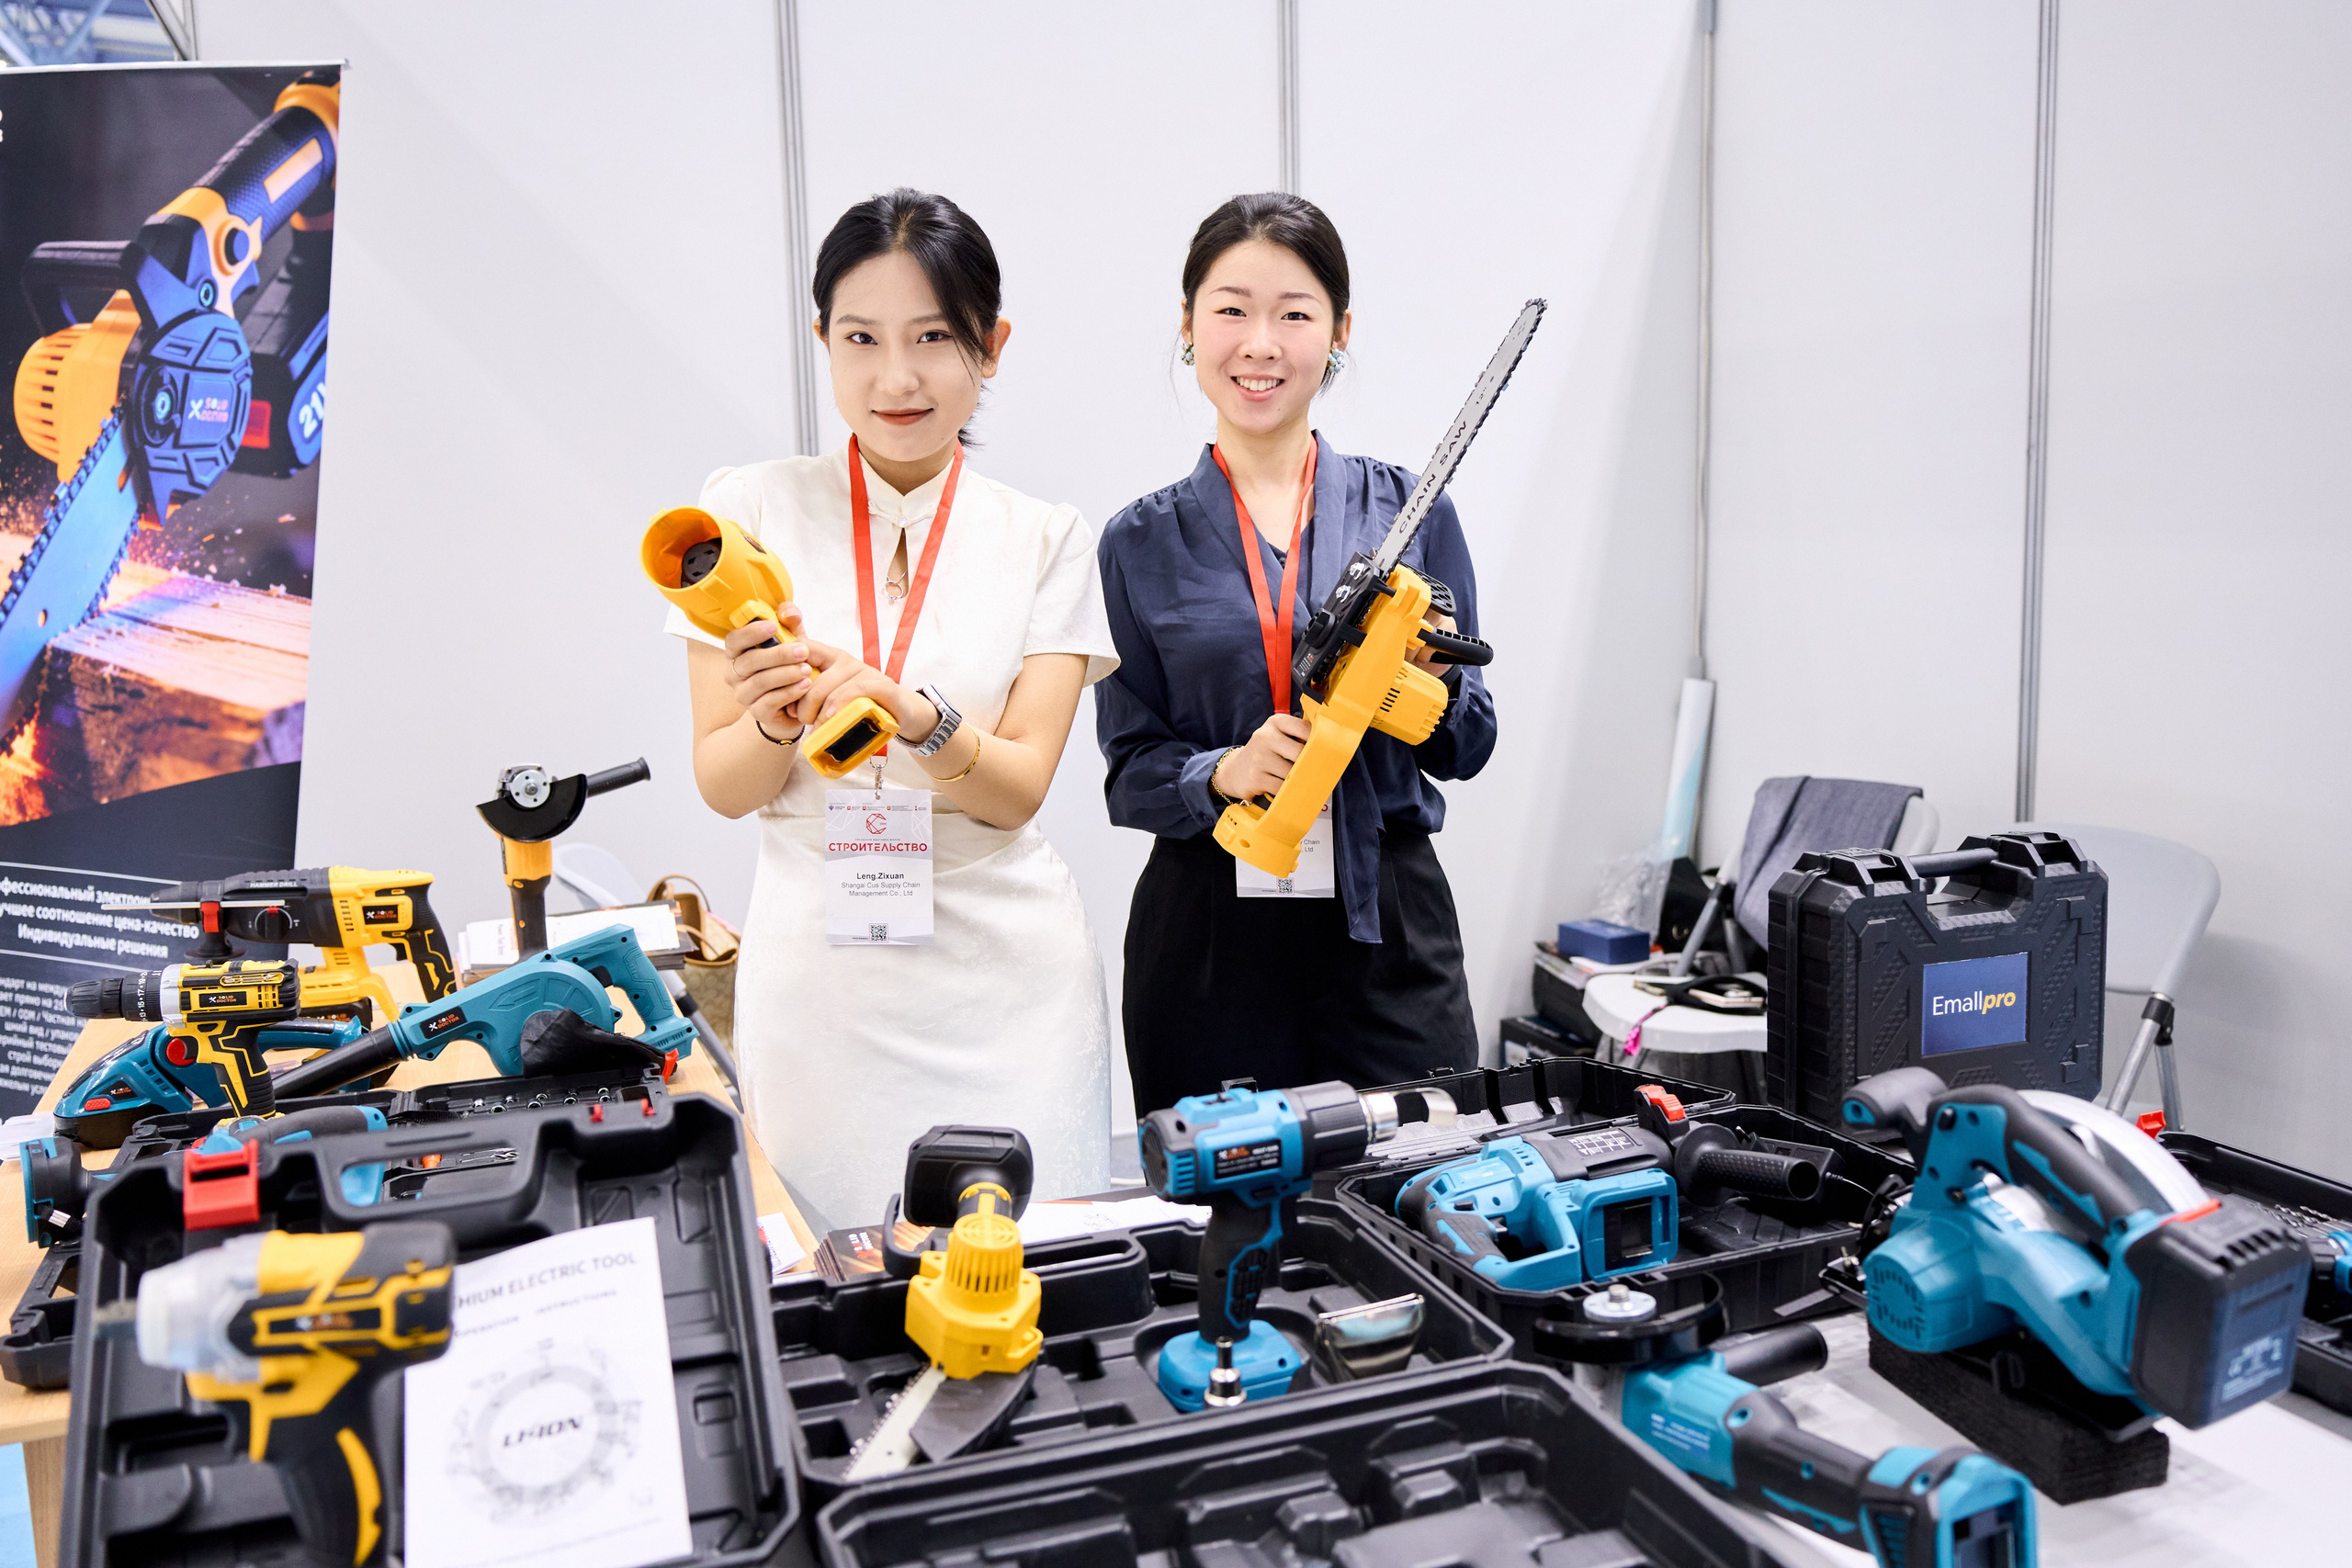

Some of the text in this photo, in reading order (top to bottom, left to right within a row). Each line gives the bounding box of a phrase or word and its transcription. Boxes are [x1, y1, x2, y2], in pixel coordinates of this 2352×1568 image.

[1399, 421, 1466, 534] CHAIN SAW
[829, 842, 928, 852] СТРОИТЕЛЬСТВО
[0, 876, 95, 902] фессиональный
[856, 873, 904, 881] Leng.Zixuan
[36, 906, 114, 928] соотношение
[114, 915, 199, 939] цена-качество
[17, 923, 168, 958] Индивидуальные решения
[1933, 990, 2016, 1016] Emallpro
[437, 1013, 455, 1024] SOLID
[438, 1016, 459, 1029] DOCTOR
[458, 1252, 637, 1309] HIUM ELECTRIC TOOL
